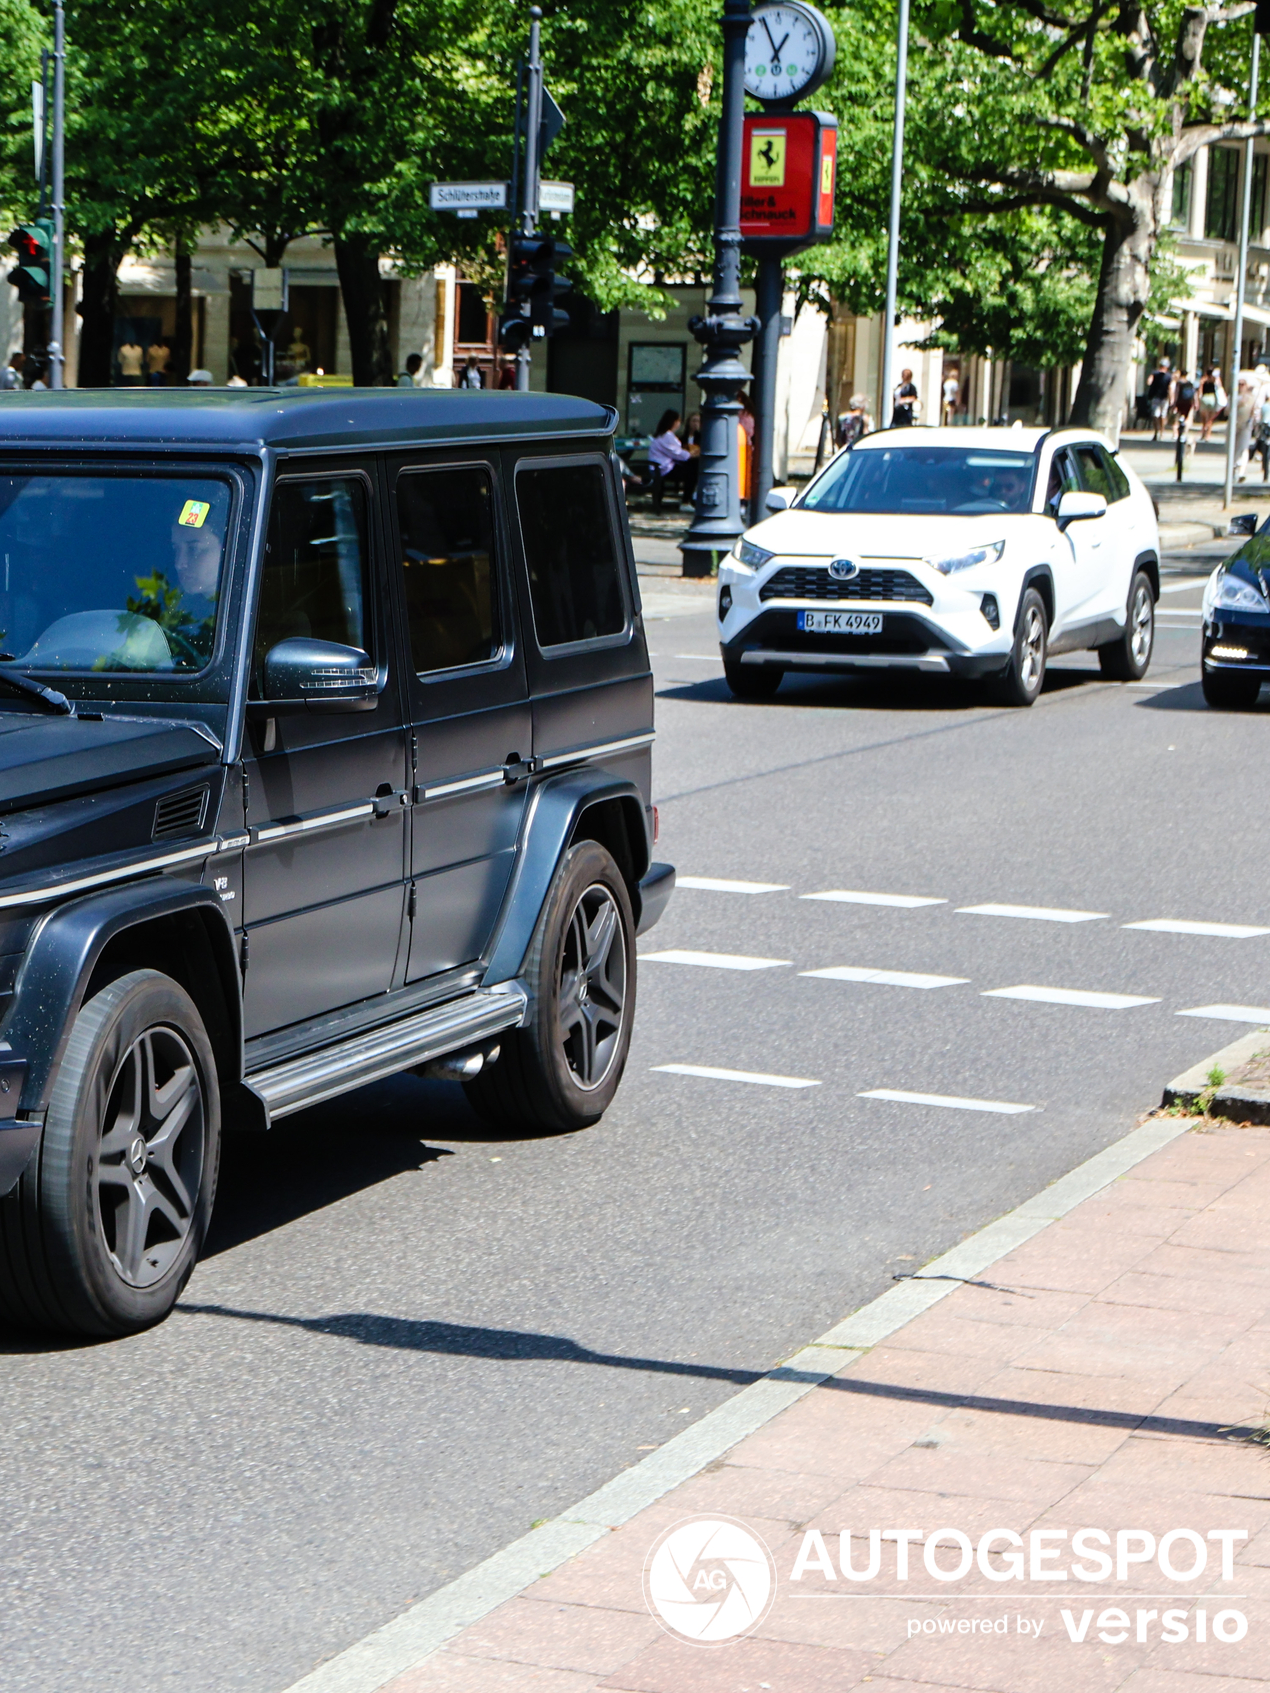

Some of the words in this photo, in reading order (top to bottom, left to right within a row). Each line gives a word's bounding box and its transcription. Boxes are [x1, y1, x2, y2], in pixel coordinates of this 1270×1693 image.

[437, 187, 501, 204] Schlüterstraße
[767, 195, 777, 208] &
[186, 512, 199, 523] 23
[806, 614, 815, 627] B
[824, 613, 843, 629] FK
[845, 615, 880, 630] 4949
